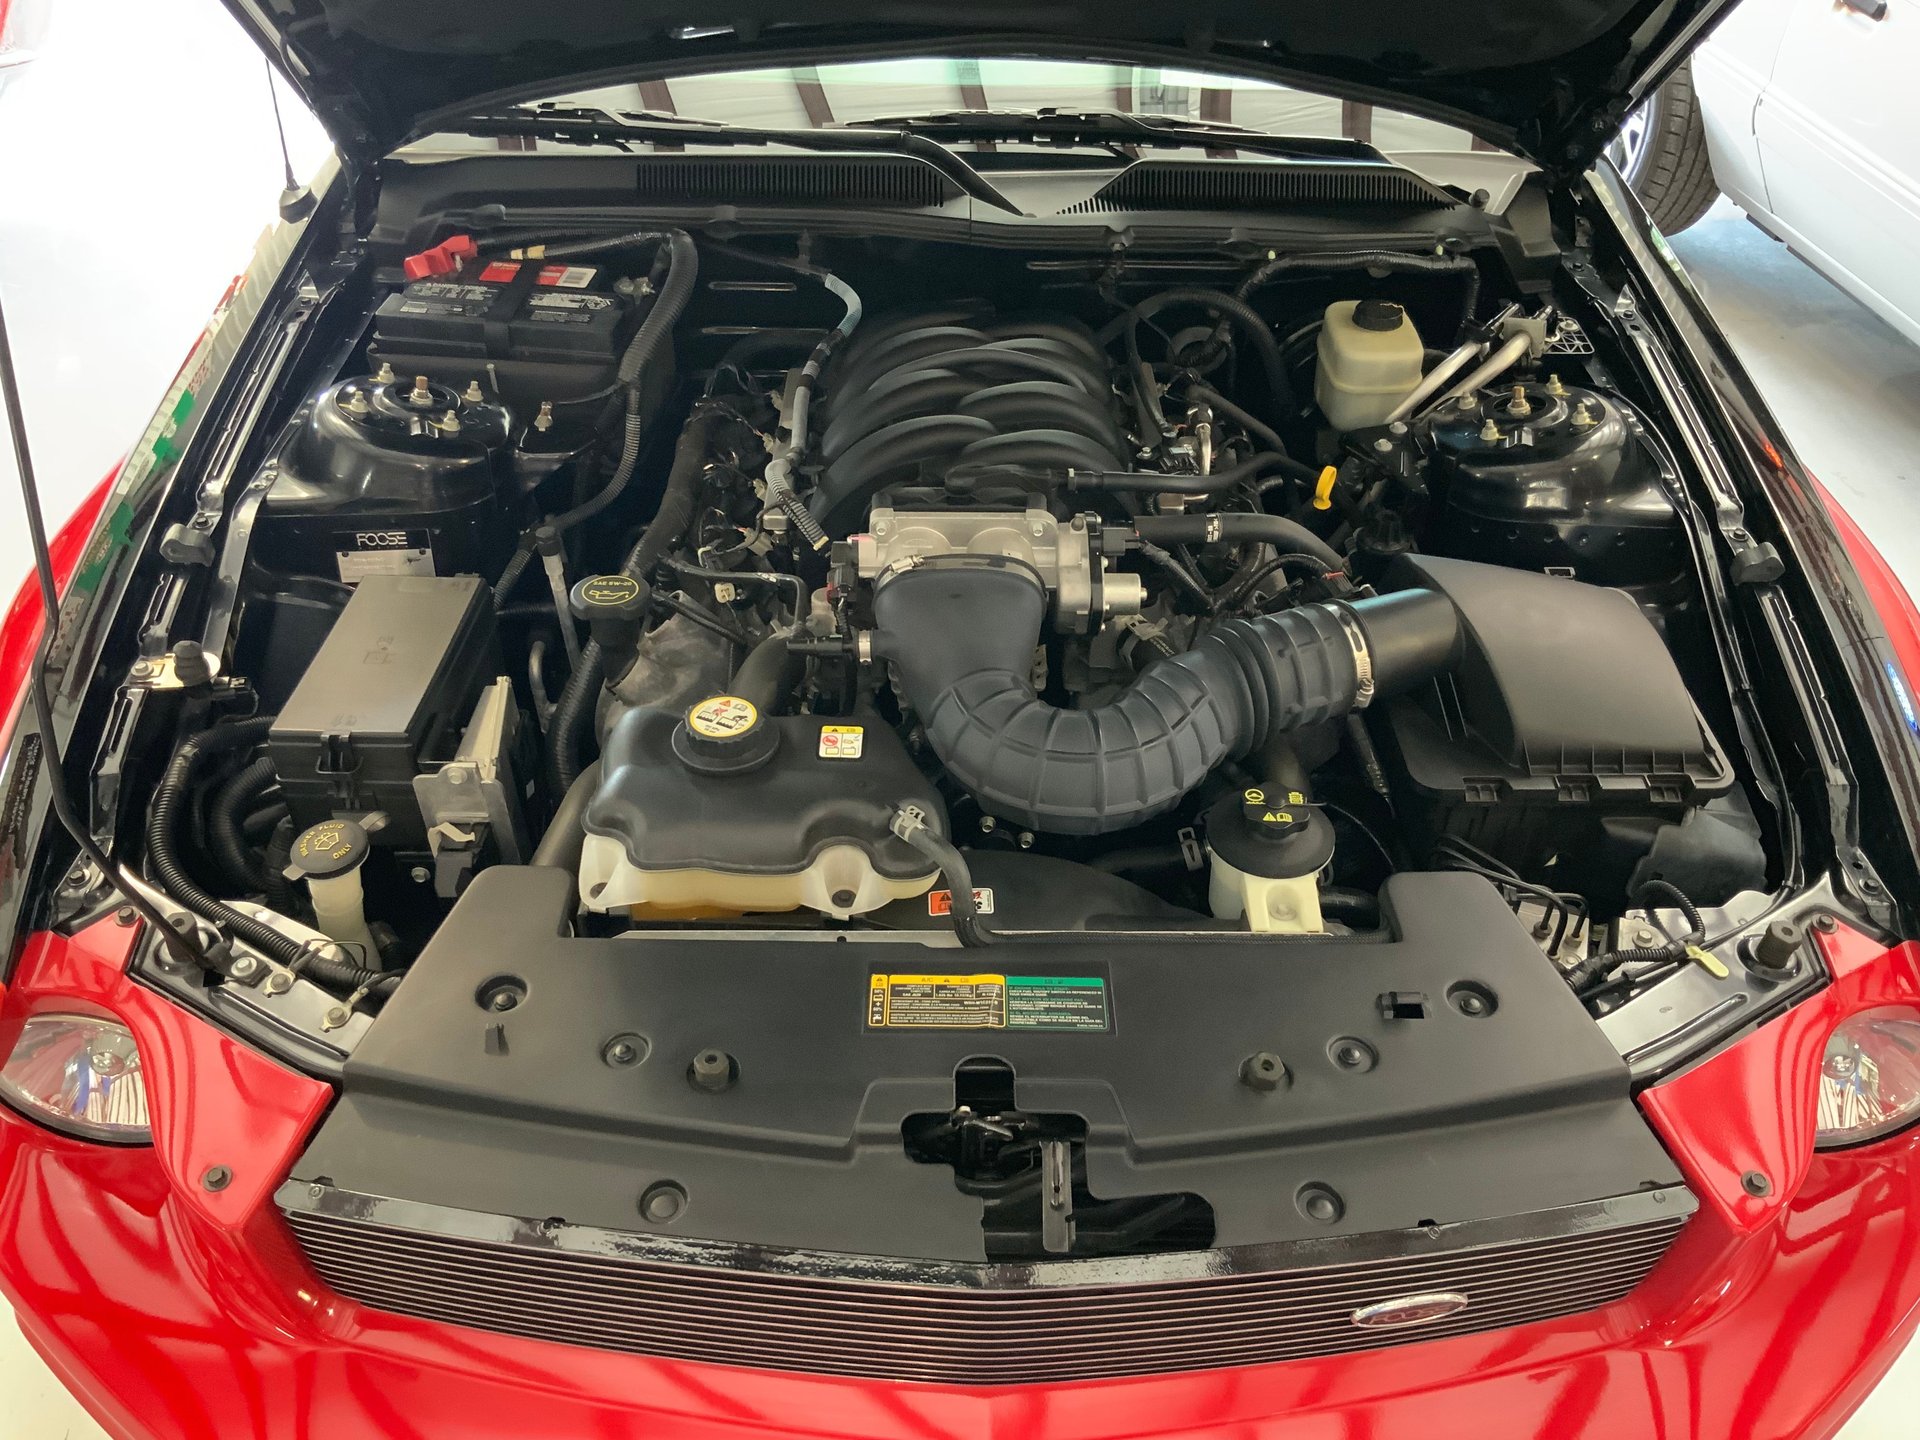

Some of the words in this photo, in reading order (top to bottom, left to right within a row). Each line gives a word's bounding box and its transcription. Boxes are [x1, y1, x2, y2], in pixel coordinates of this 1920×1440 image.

[356, 531, 407, 546] FOOSE
[319, 823, 345, 831] FLUID
[332, 842, 352, 859] ONLY
